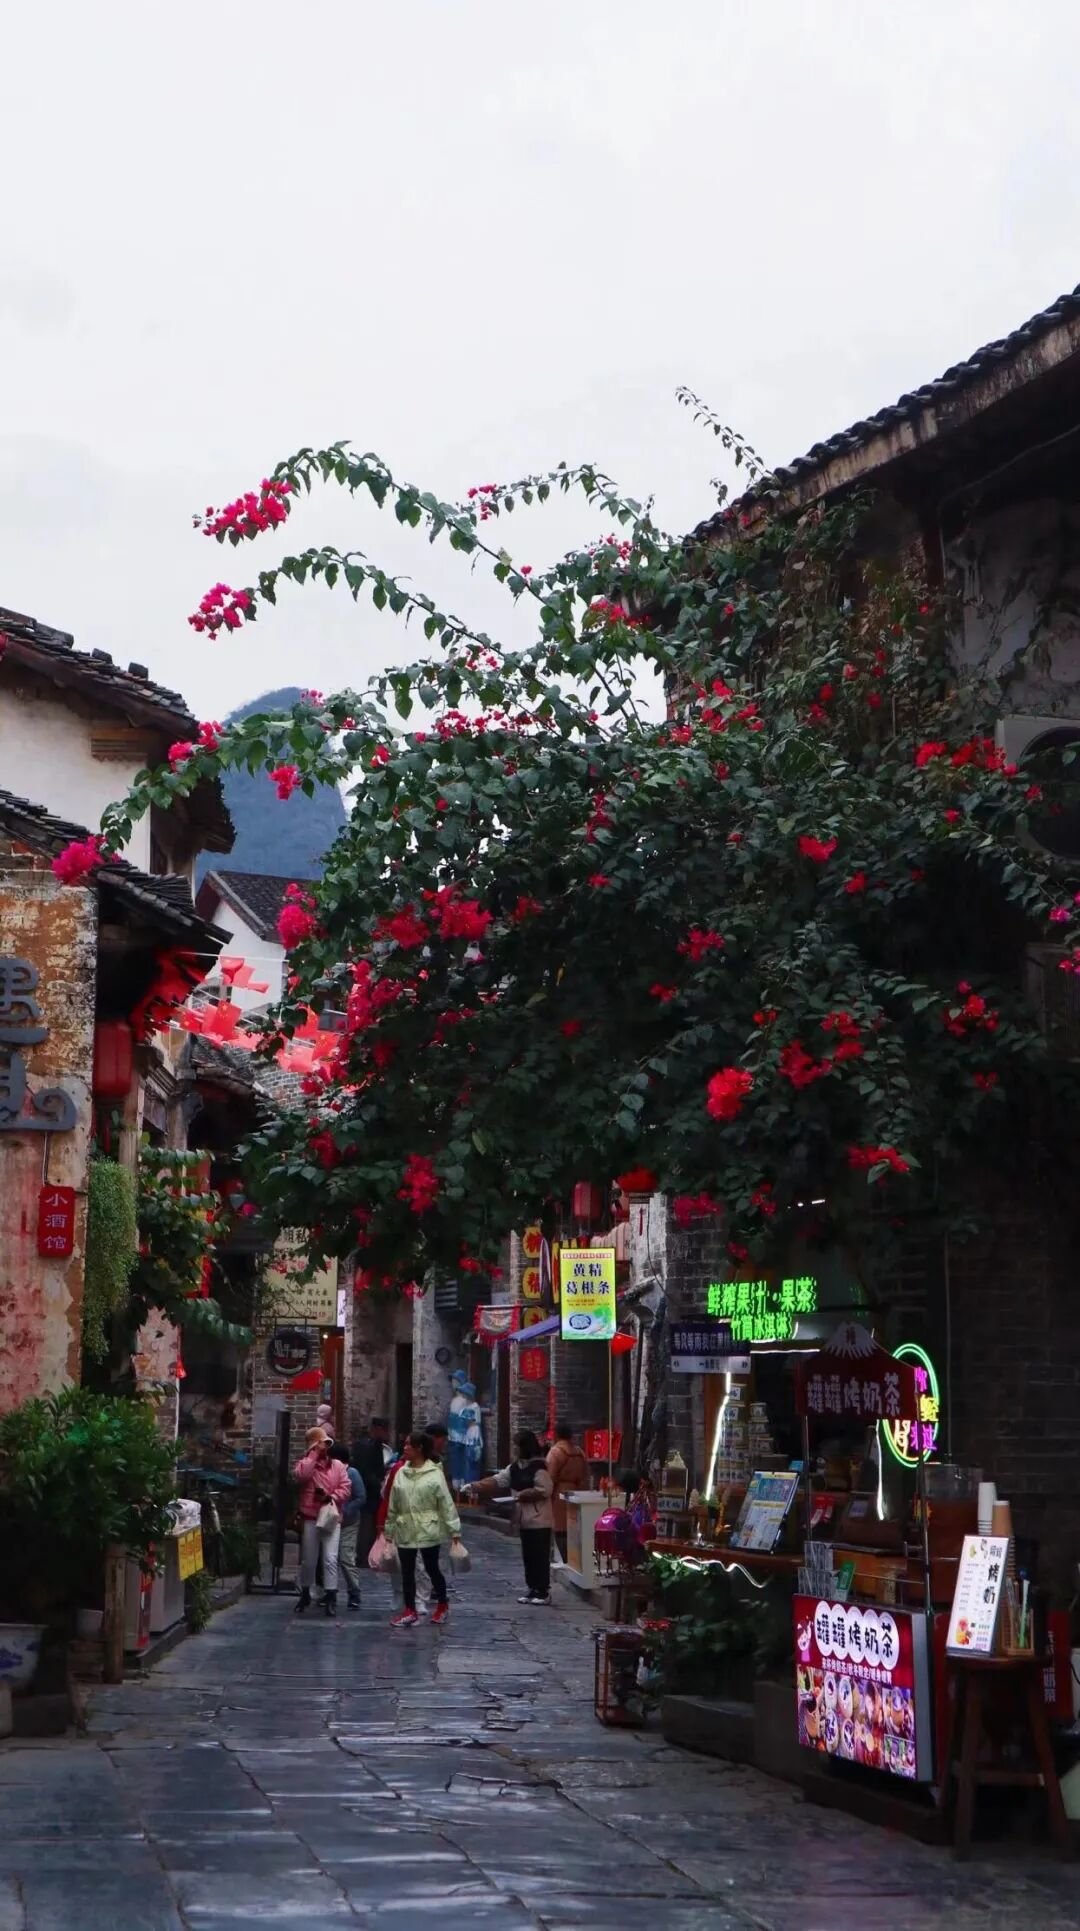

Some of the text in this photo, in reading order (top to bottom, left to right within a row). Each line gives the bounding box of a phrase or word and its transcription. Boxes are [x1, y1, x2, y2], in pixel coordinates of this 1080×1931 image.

[44, 1193, 68, 1250] 小酒馆
[566, 1281, 610, 1295] 葛根条
[574, 1262, 602, 1277] 黄精
[806, 1371, 901, 1416] 罐罐烤奶茶
[816, 1613, 893, 1658] 罐罐烤奶茶
